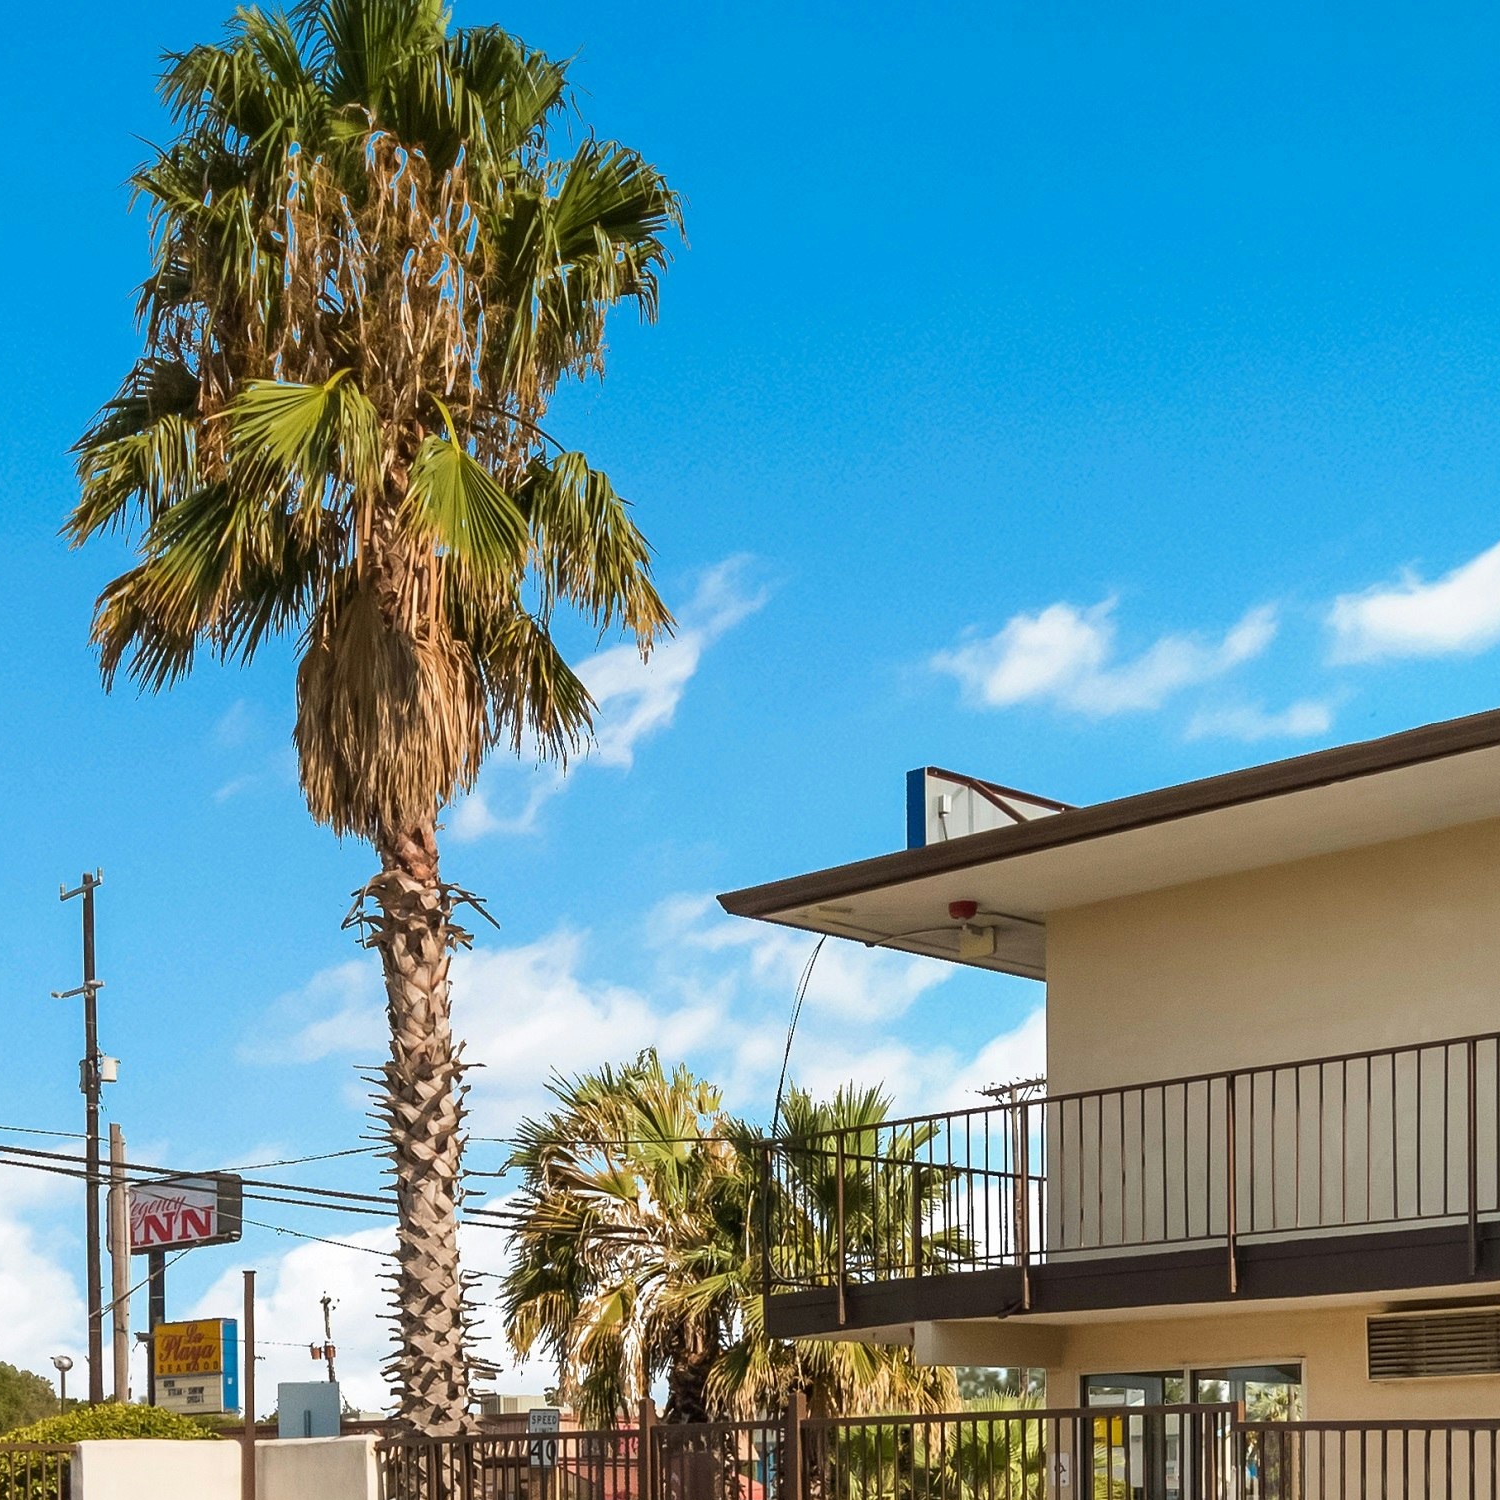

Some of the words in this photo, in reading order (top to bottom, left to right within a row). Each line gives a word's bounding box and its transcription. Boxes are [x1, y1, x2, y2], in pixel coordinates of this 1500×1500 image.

[186, 1323, 204, 1343] La
[159, 1334, 216, 1369] Playa
[531, 1415, 557, 1425] SPEED
[530, 1439, 557, 1461] 40
